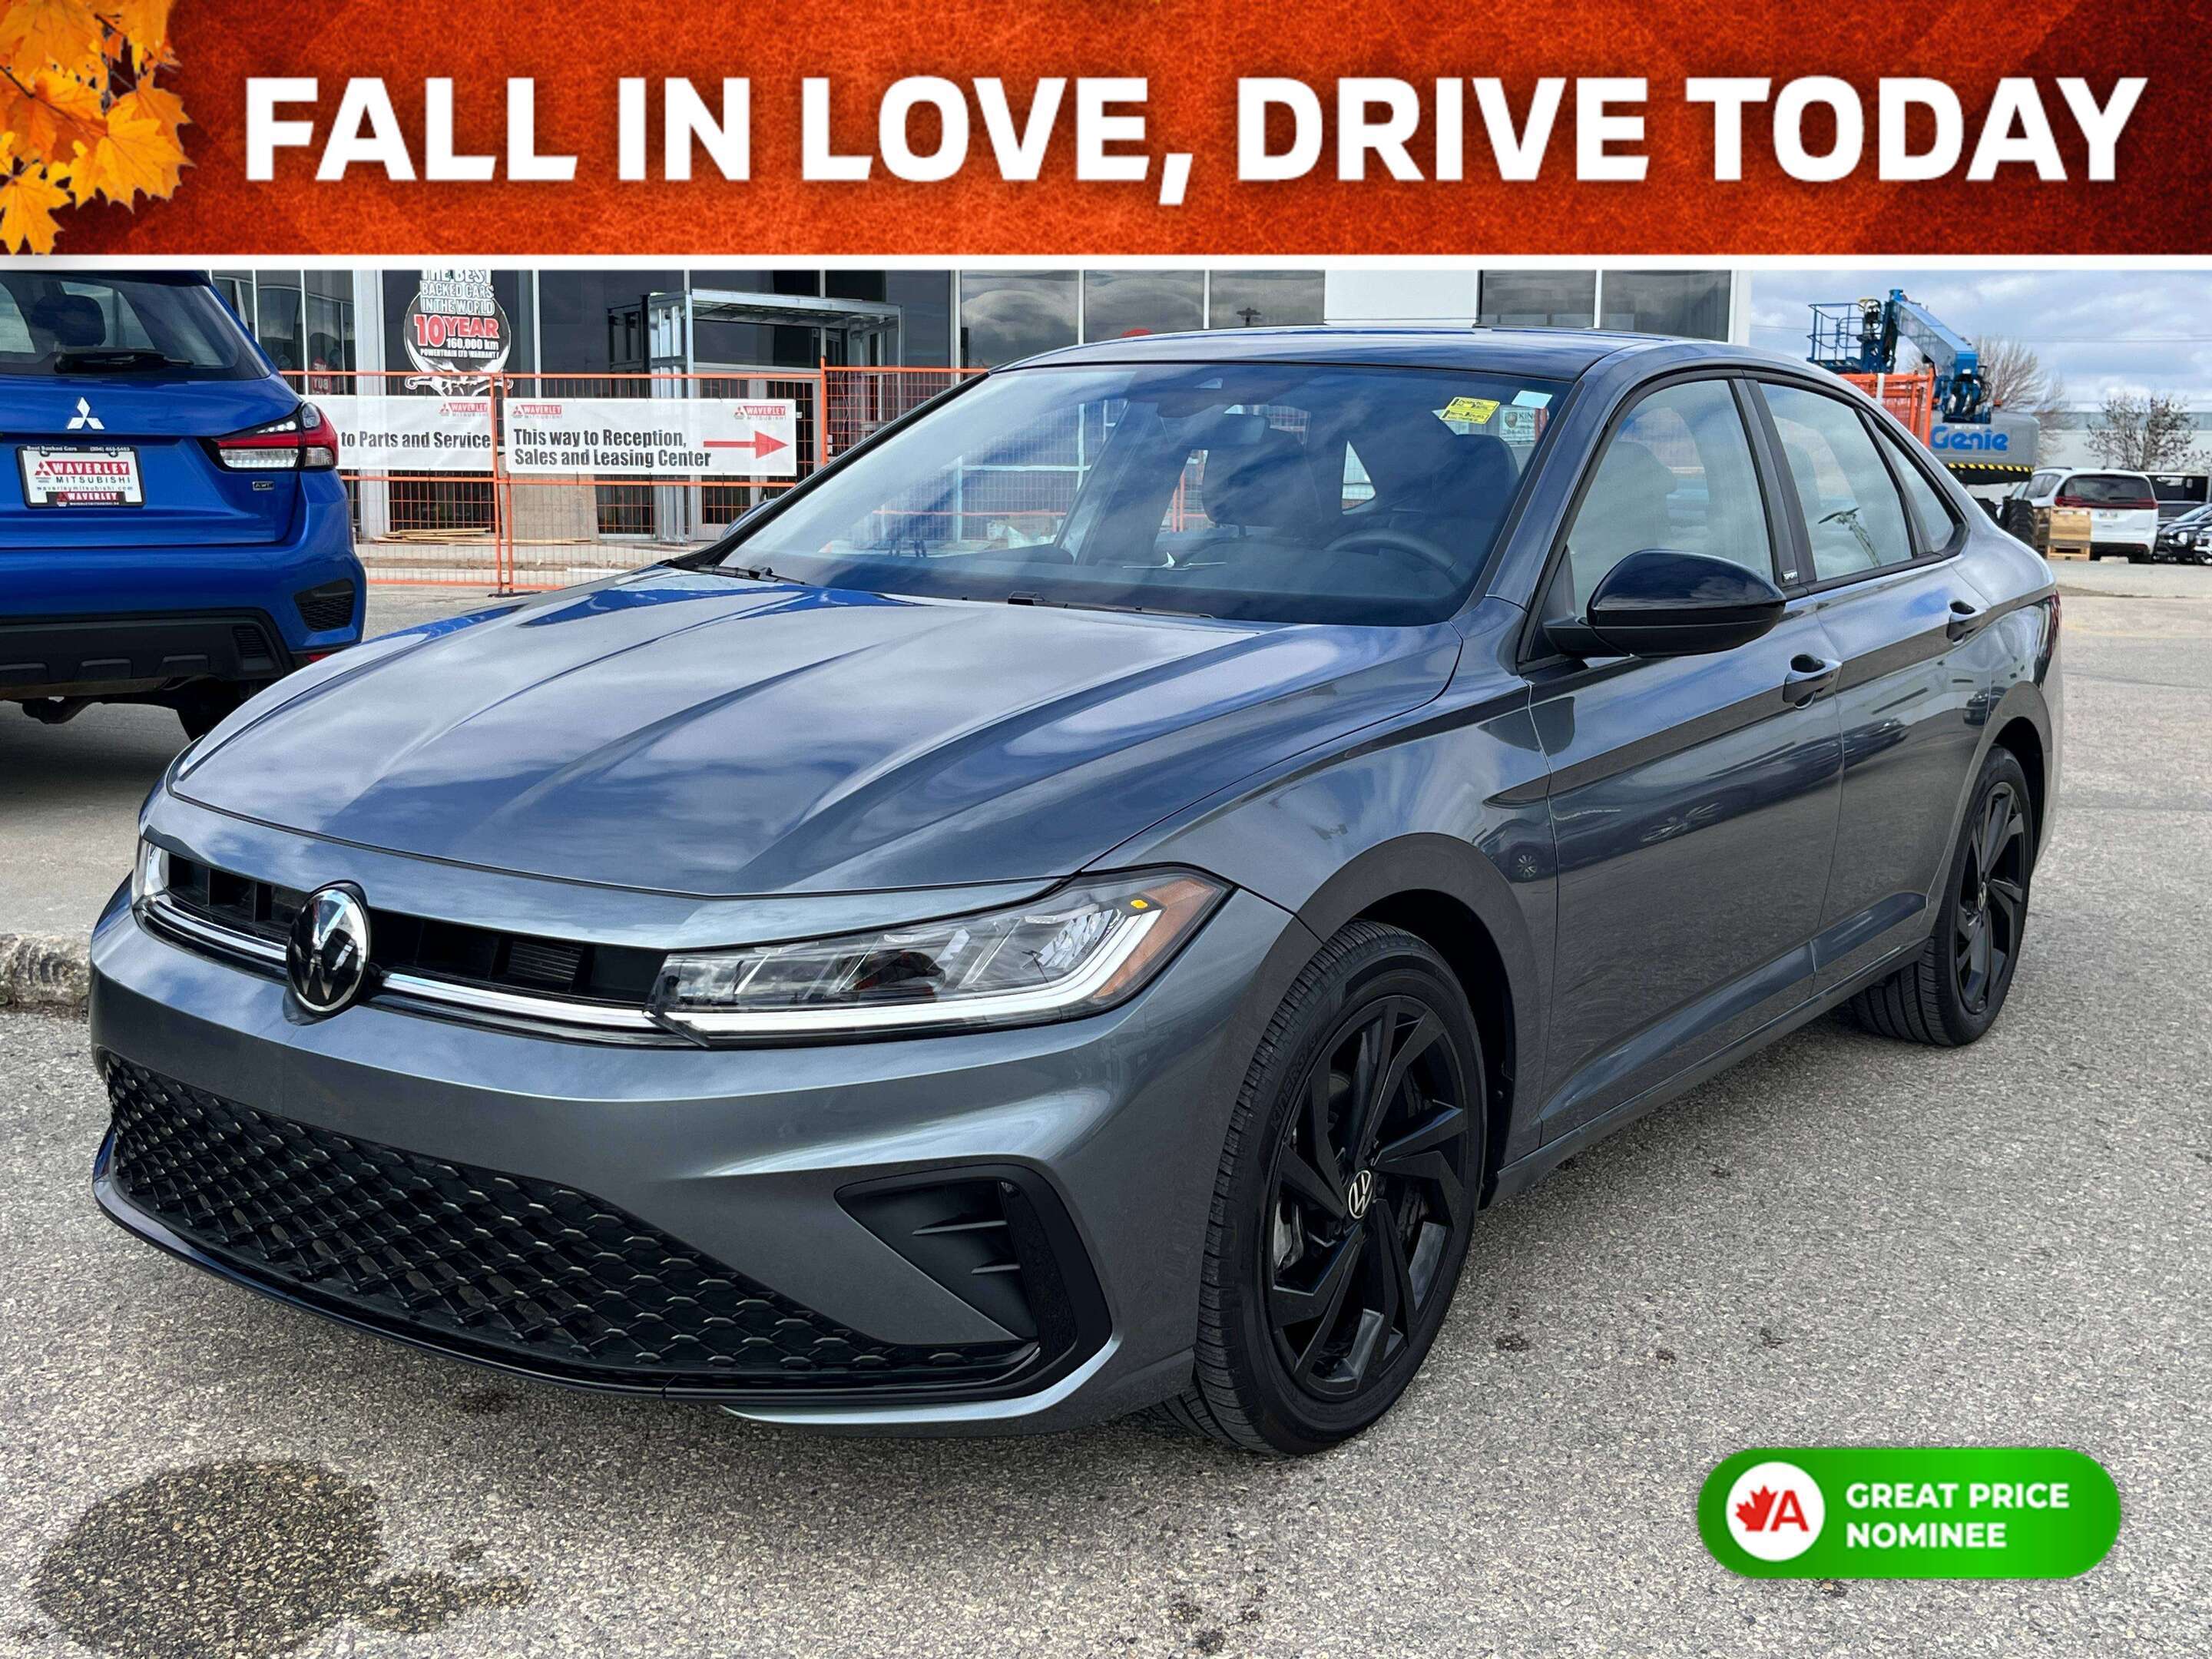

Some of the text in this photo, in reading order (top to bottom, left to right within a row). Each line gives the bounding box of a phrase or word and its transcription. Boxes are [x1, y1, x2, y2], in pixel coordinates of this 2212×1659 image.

[422, 282, 495, 299] BACKED CARS
[422, 297, 495, 315] IN THE WORLD
[414, 314, 500, 347] 10 YEAR
[446, 338, 499, 350] 160,000 km
[451, 403, 488, 412] WAVERLEY
[523, 405, 561, 414] WAVERLEY
[745, 406, 786, 415] WAVERLEY
[341, 431, 491, 449] to Parts and Service
[514, 429, 687, 448] This way to Reception,
[1930, 426, 2009, 452] Genie
[515, 449, 711, 468] Sales and Leasing Center
[51, 462, 127, 474] WAVERLEY
[67, 492, 118, 501] WAVERLEY
